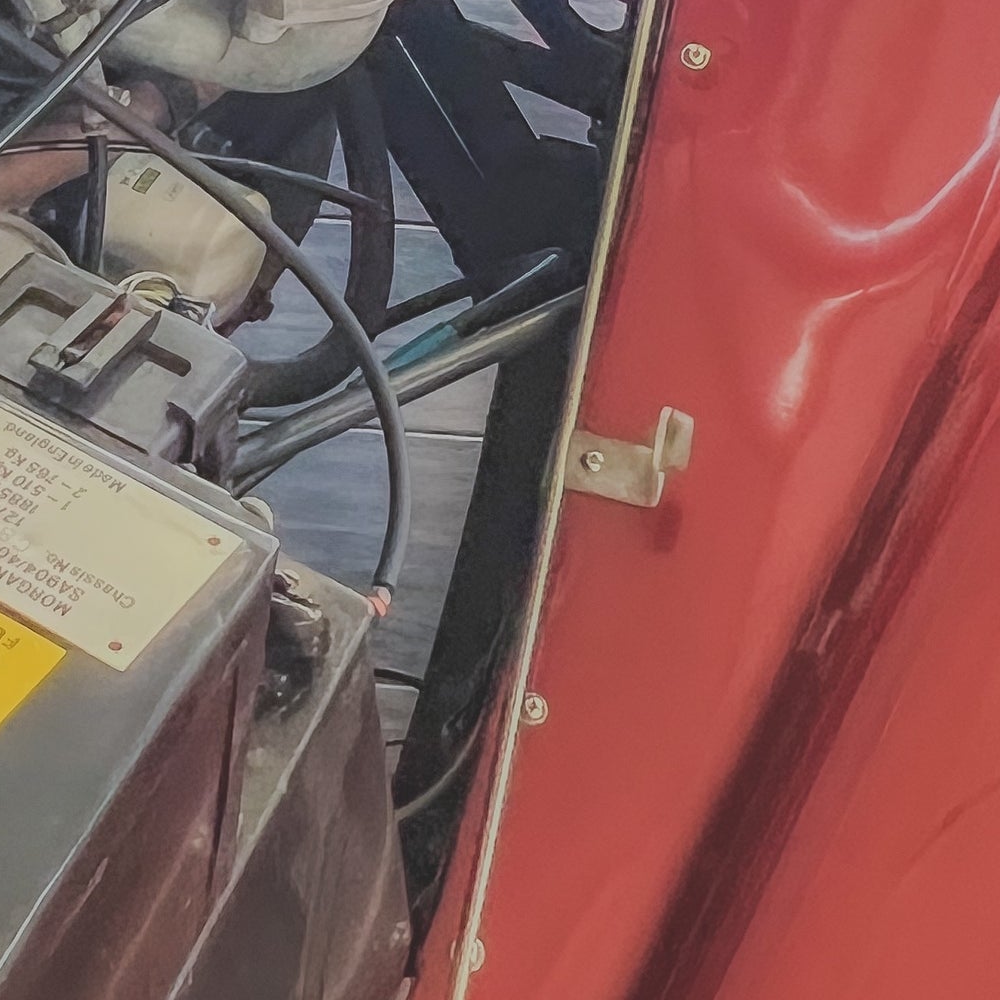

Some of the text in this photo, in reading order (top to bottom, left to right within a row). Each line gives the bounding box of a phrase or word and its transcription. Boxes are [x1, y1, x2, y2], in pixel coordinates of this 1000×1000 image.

[2, 422, 128, 494] Made in England
[11, 475, 47, 497] 510
[68, 566, 136, 609] Chassis
